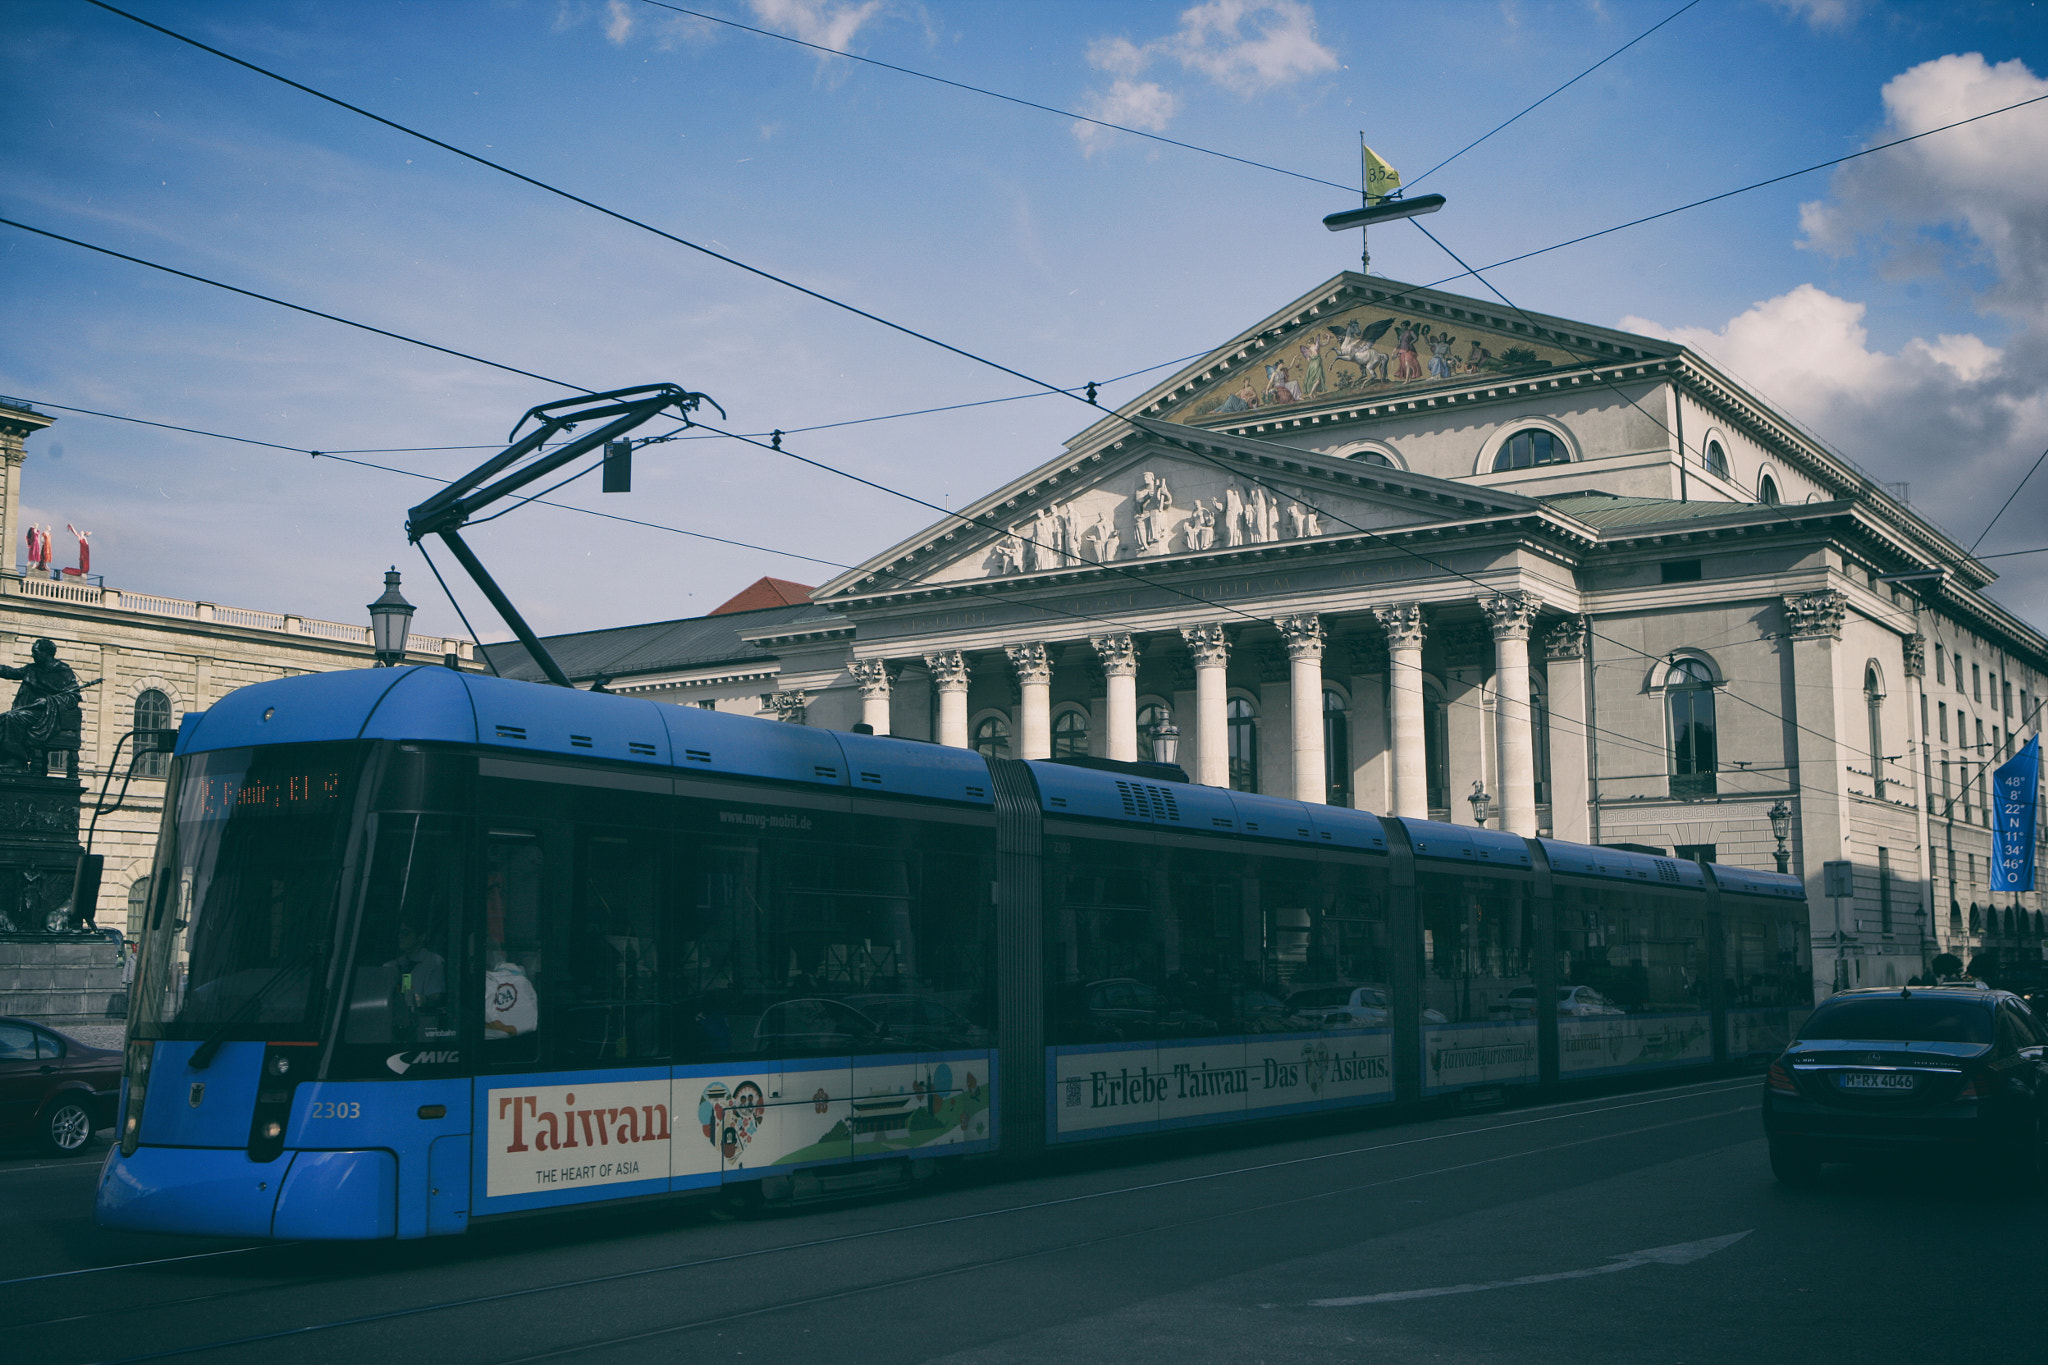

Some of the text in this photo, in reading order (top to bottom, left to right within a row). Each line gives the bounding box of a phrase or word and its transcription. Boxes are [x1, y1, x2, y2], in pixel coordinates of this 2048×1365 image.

[720, 811, 813, 831] www.mvg-mobil.de
[2010, 817, 2019, 828] N
[2007, 872, 2018, 883] O
[424, 1029, 457, 1038] variobahn
[412, 1050, 460, 1064] MVG
[1090, 1067, 1168, 1108] Erlebe
[1331, 1051, 1389, 1082] Asiens.
[1846, 1074, 1912, 1088] M RX 4046
[312, 1101, 361, 1119] 2303
[499, 1092, 671, 1153] Taiwan
[535, 1161, 640, 1184] THE HEART OF ASIA
